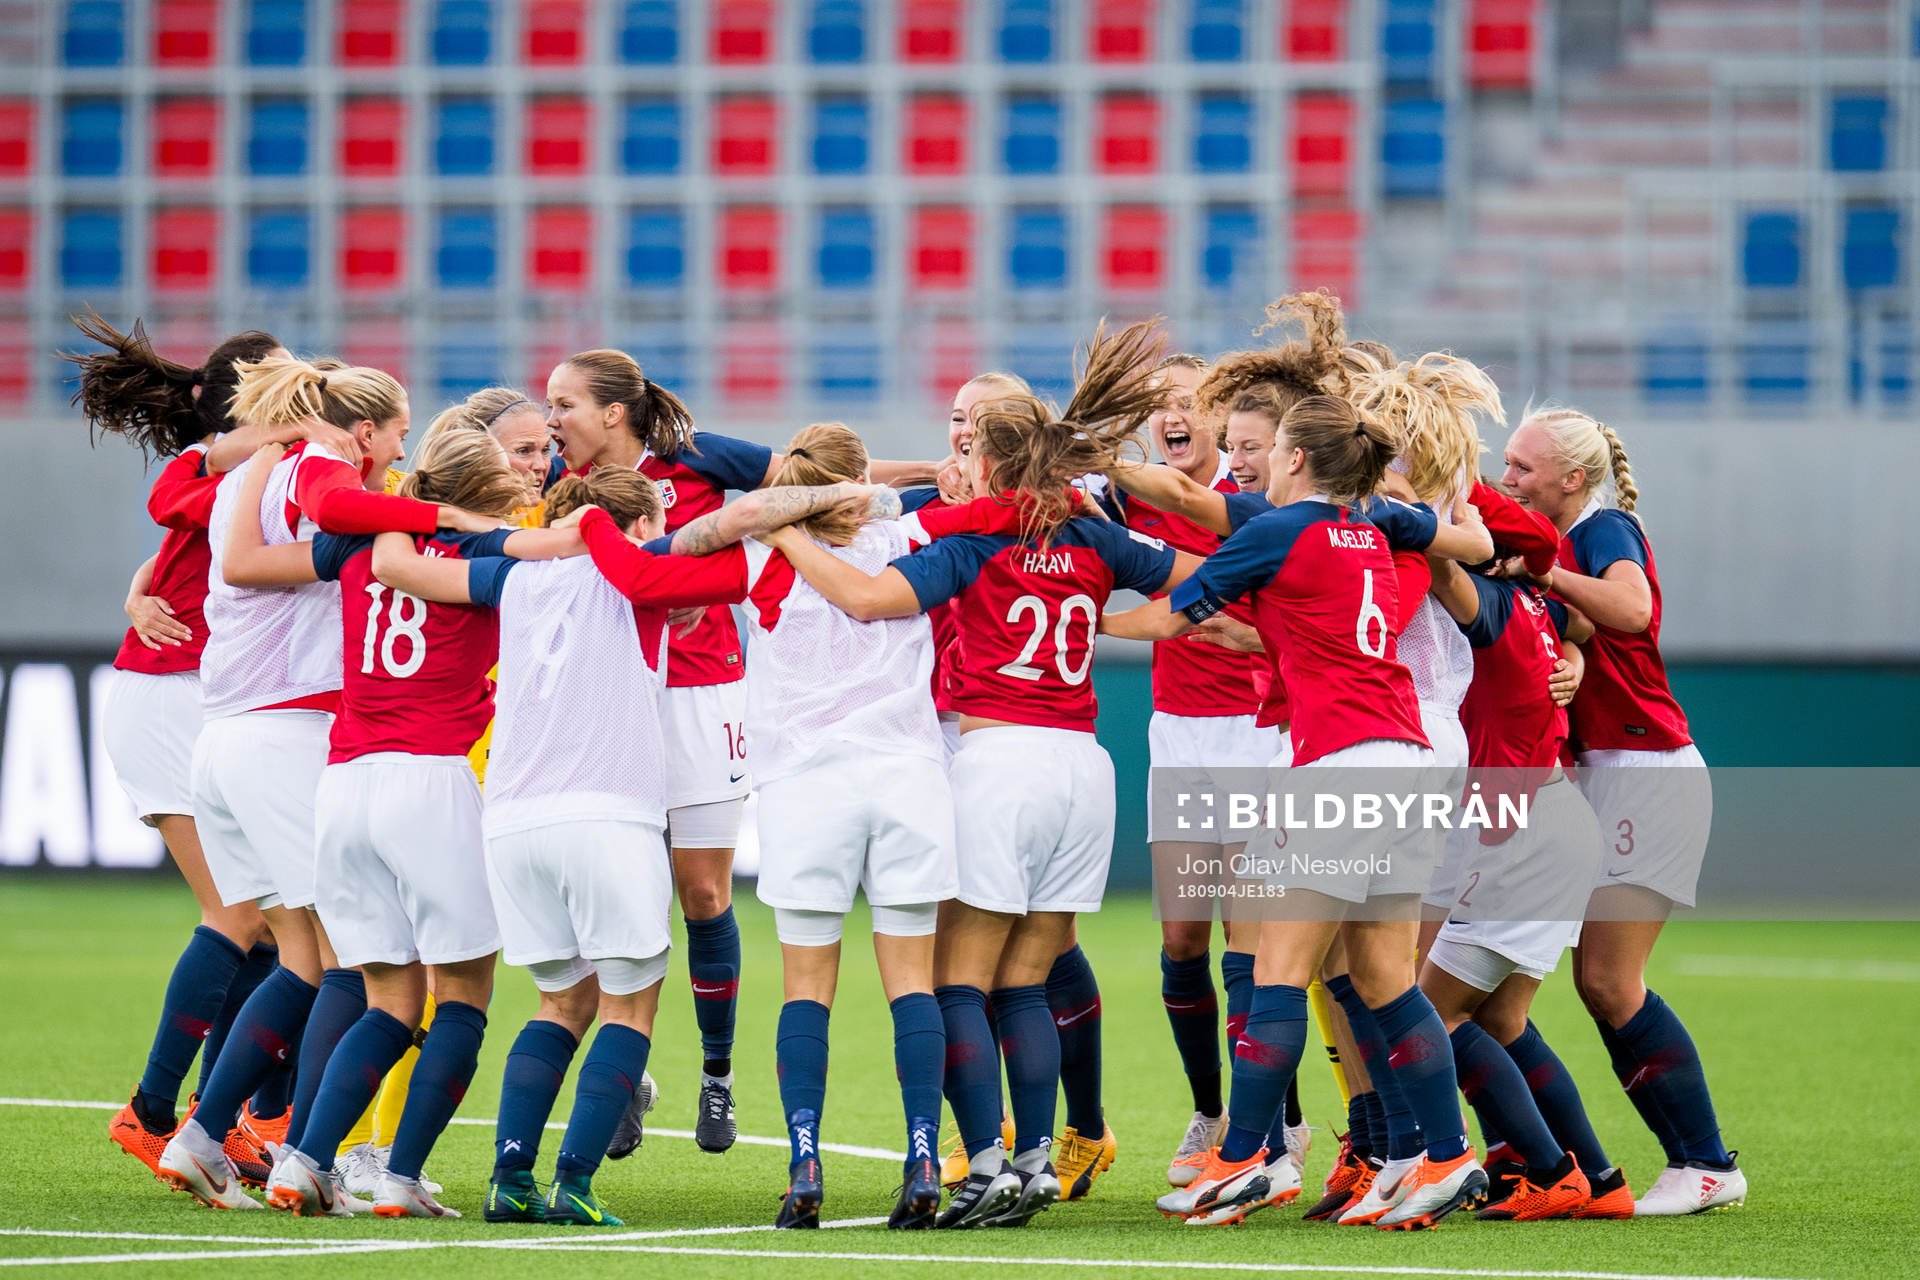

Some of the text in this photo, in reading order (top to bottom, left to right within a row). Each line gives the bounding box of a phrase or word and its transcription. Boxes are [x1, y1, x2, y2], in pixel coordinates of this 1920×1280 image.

[1326, 526, 1378, 550] MJELDE
[1022, 552, 1076, 575] HAAVI
[360, 581, 428, 679] 18
[1355, 568, 1388, 660] 6
[995, 593, 1098, 686] 20
[722, 721, 748, 761] 16
[1614, 817, 1636, 857] 3
[1457, 870, 1481, 908] 2
